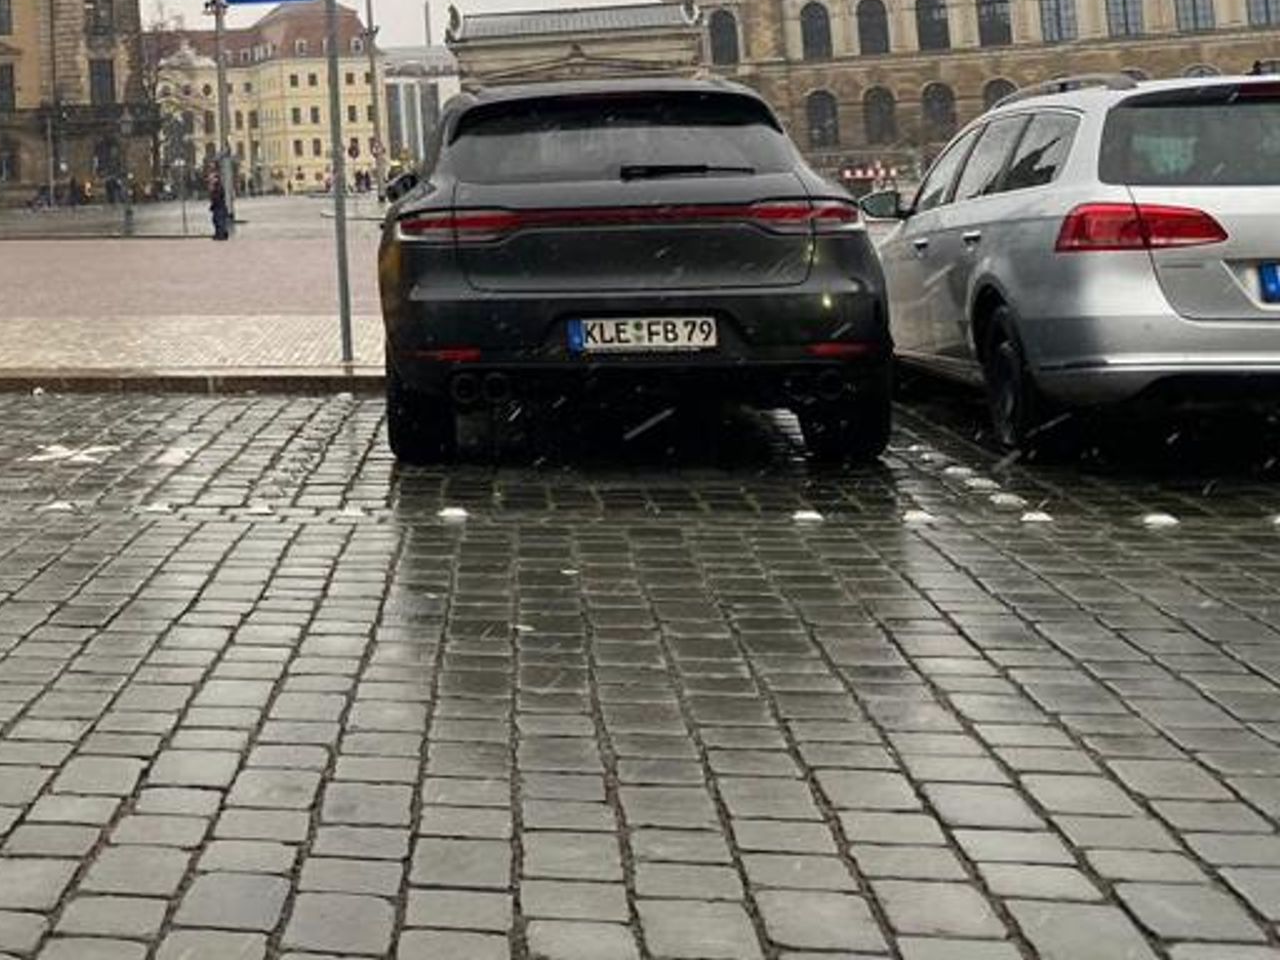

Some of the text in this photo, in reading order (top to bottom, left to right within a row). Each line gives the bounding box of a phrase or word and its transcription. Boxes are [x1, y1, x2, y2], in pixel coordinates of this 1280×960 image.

[584, 320, 713, 344] KLE FB 79
